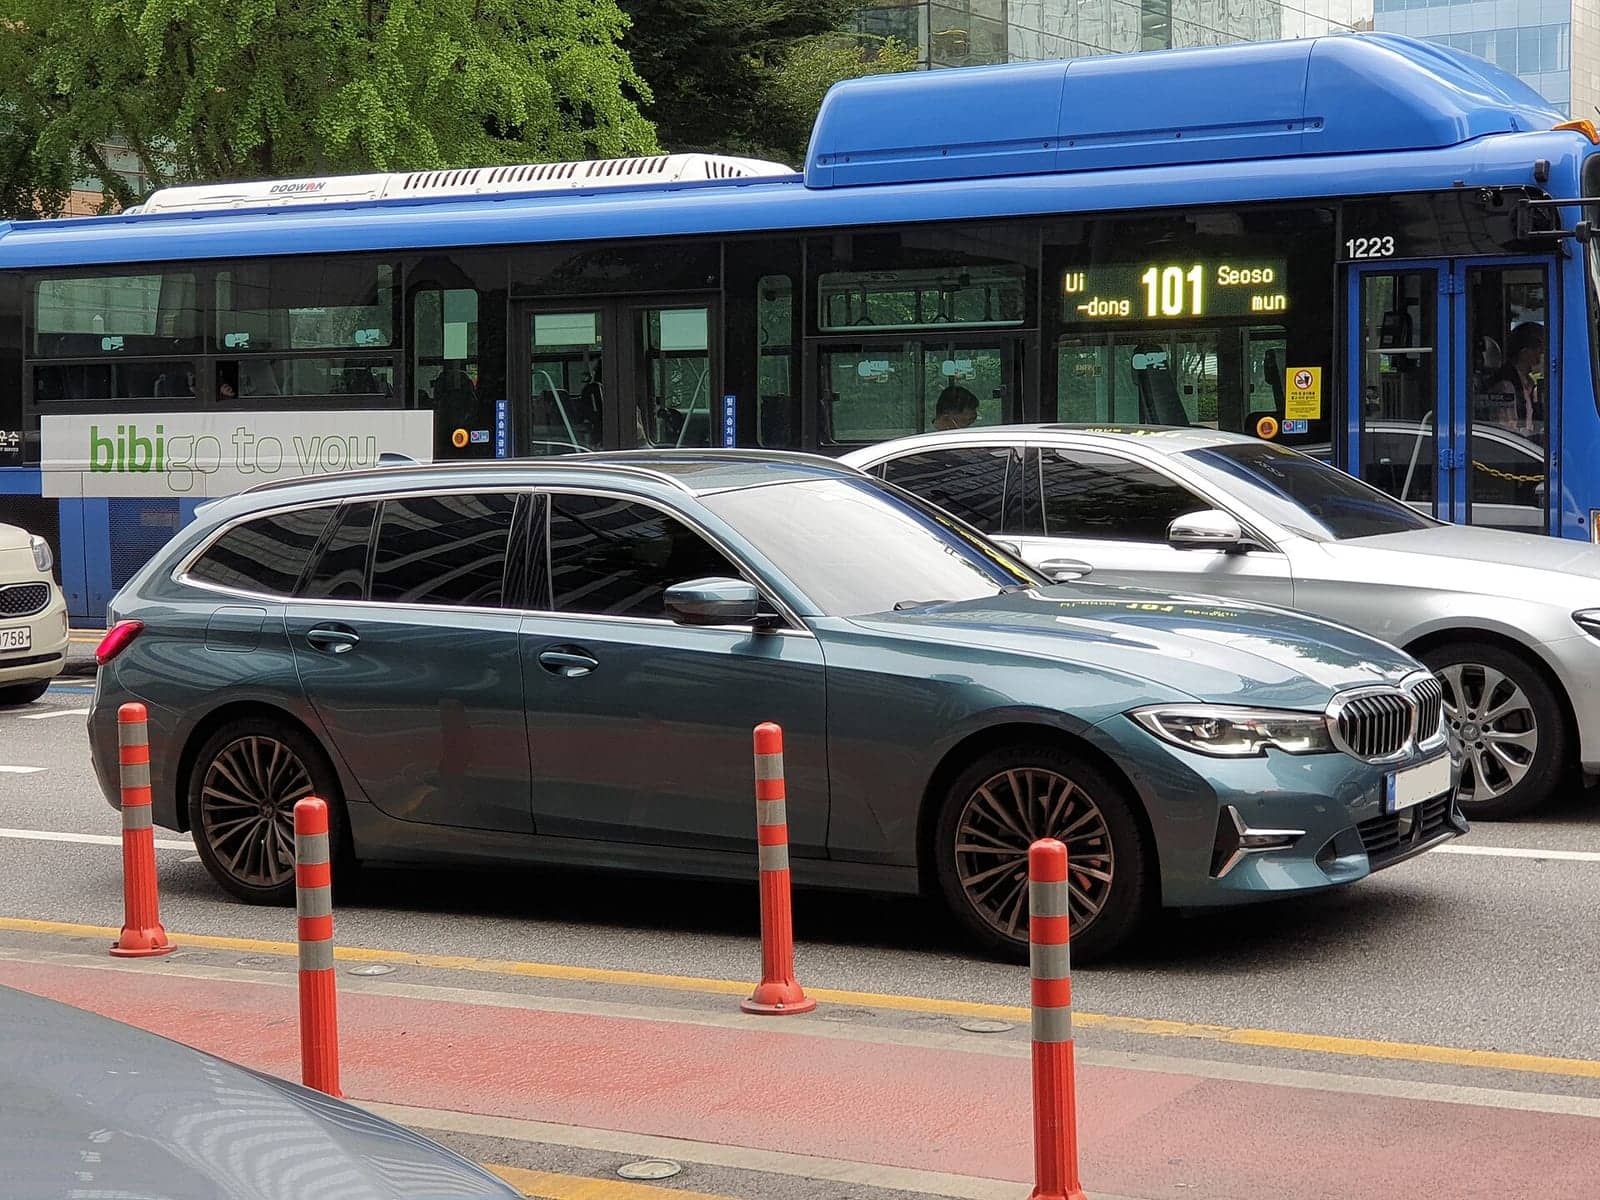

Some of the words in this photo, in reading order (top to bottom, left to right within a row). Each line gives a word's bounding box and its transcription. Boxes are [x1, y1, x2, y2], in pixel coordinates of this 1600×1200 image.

[1346, 236, 1395, 259] 1223
[1065, 272, 1084, 293] Ui
[1217, 266, 1274, 286] Seoso
[1142, 265, 1203, 317] 101
[1077, 297, 1130, 316] -dong
[1251, 295, 1286, 311] mun
[90, 425, 222, 492] bibigo
[231, 427, 284, 474] to
[292, 435, 377, 475] you
[0, 631, 25, 647] 758
